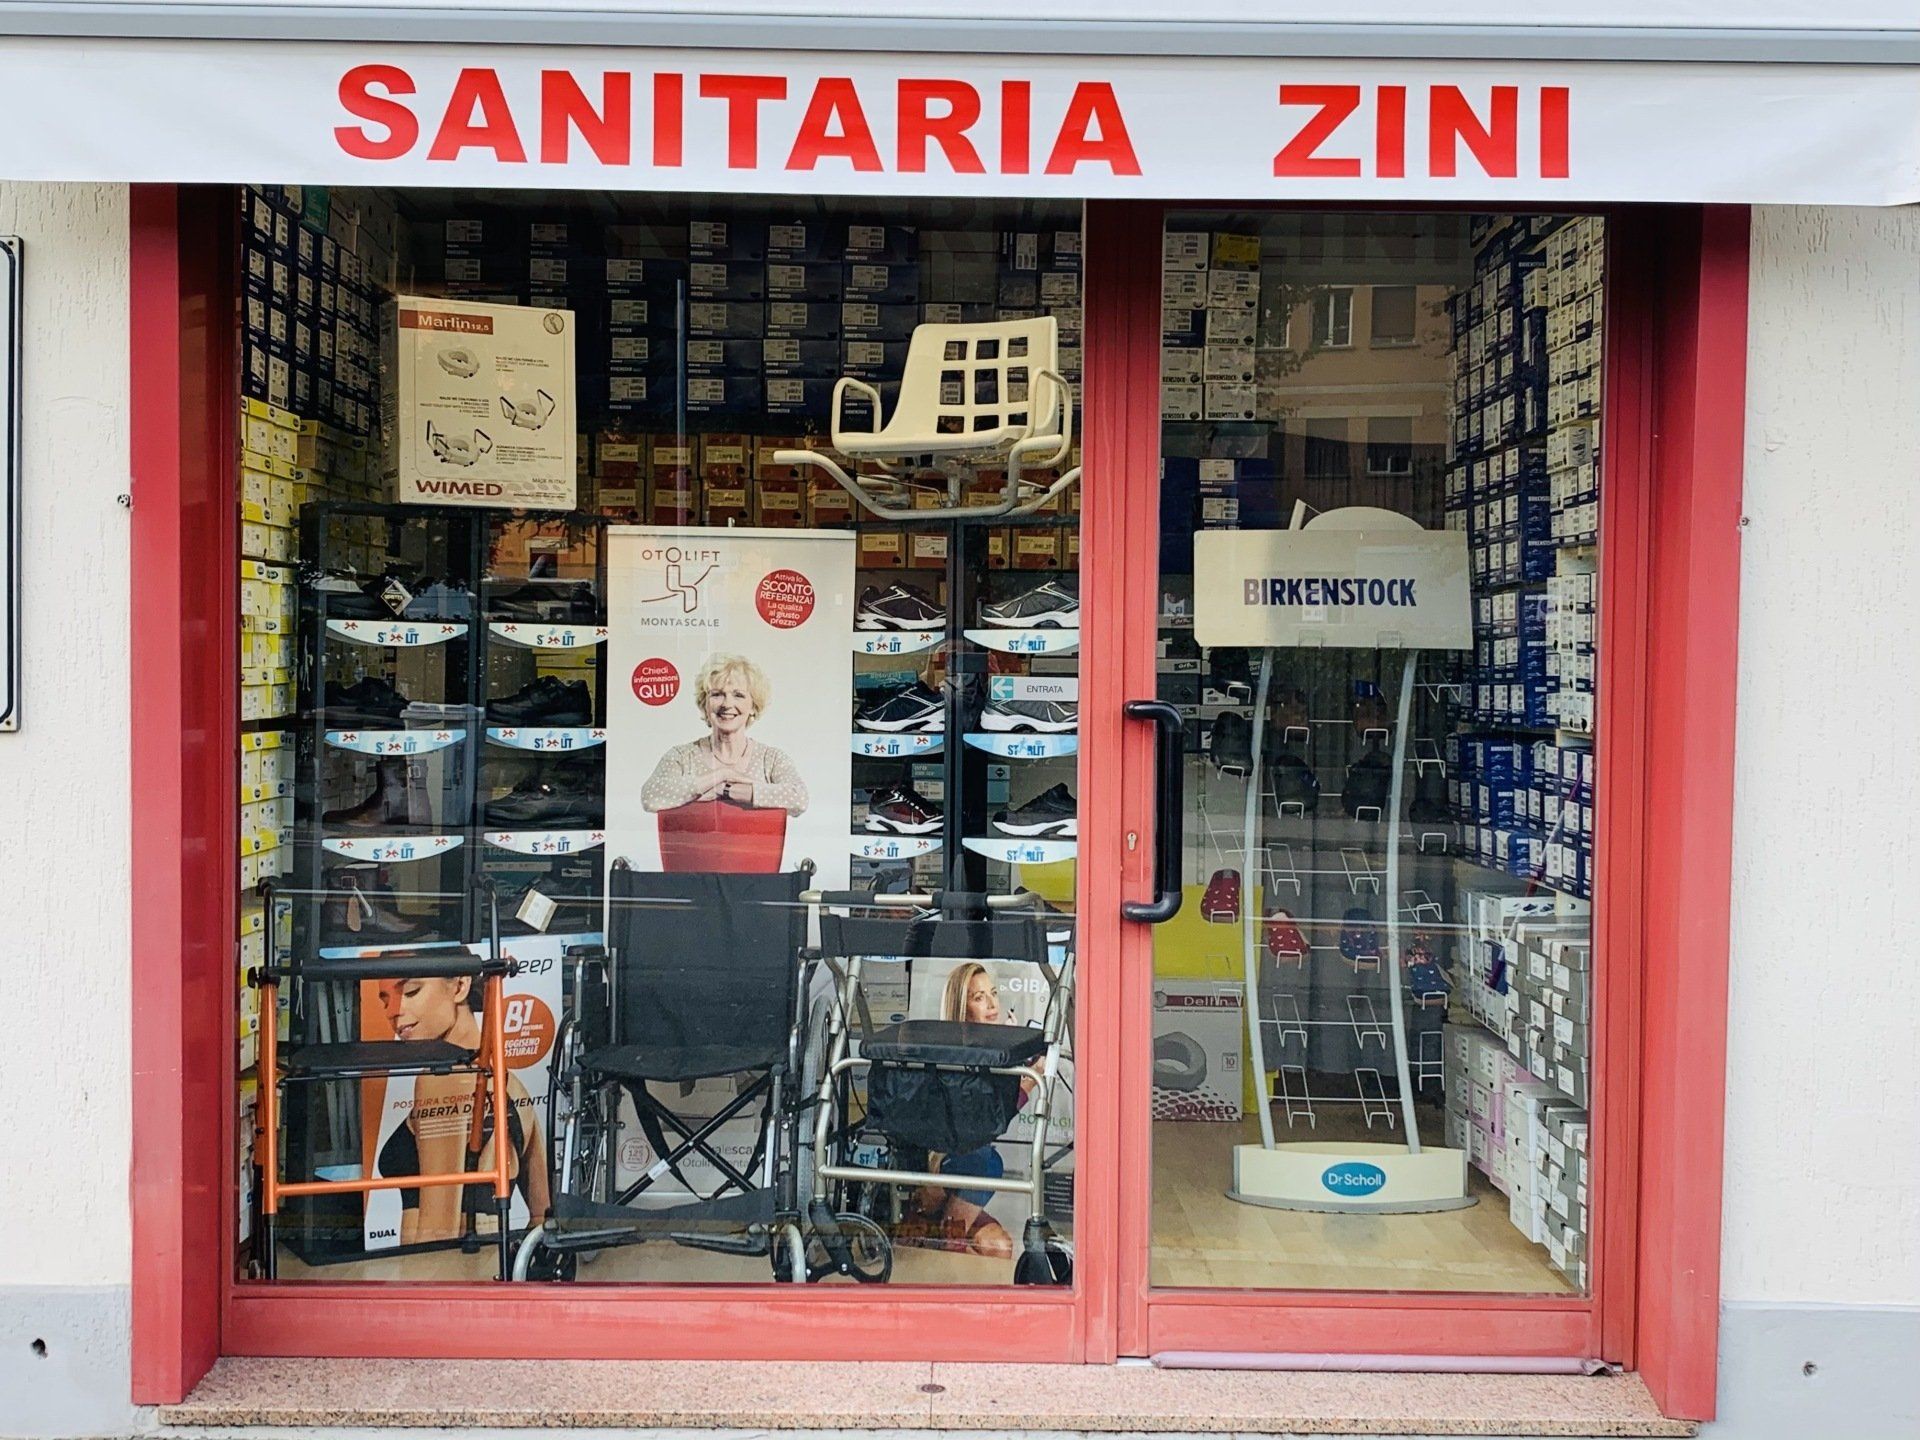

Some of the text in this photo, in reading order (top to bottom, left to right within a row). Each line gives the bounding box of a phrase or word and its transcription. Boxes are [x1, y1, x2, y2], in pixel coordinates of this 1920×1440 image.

[333, 64, 1570, 178] SANITARIA ZINI
[418, 315, 470, 330] Marlin
[416, 480, 503, 496] WIMED
[642, 547, 720, 563] OTOLIFT
[761, 580, 813, 596] SCONTO
[1244, 578, 1417, 606] BIRKENSTOCK
[760, 591, 813, 605] REFERENZA!
[768, 601, 777, 609] La
[641, 618, 719, 627] MONTASCALE
[770, 617, 797, 627] prezzo
[776, 611, 800, 620] giusto
[642, 666, 669, 675] Chiedi
[633, 675, 679, 683] informazioni
[639, 683, 674, 698] QUI!
[1026, 685, 1063, 693] ENTRATA
[517, 958, 553, 975] eep
[504, 999, 535, 1033] B1
[504, 1037, 540, 1049] EGGISENO
[393, 1098, 439, 1109] POSTURA
[1176, 1101, 1238, 1115] WIMED
[410, 1103, 459, 1119] LIBERTÀ
[1328, 1172, 1382, 1186] Dr Scholl
[369, 1229, 397, 1239] DUAL
